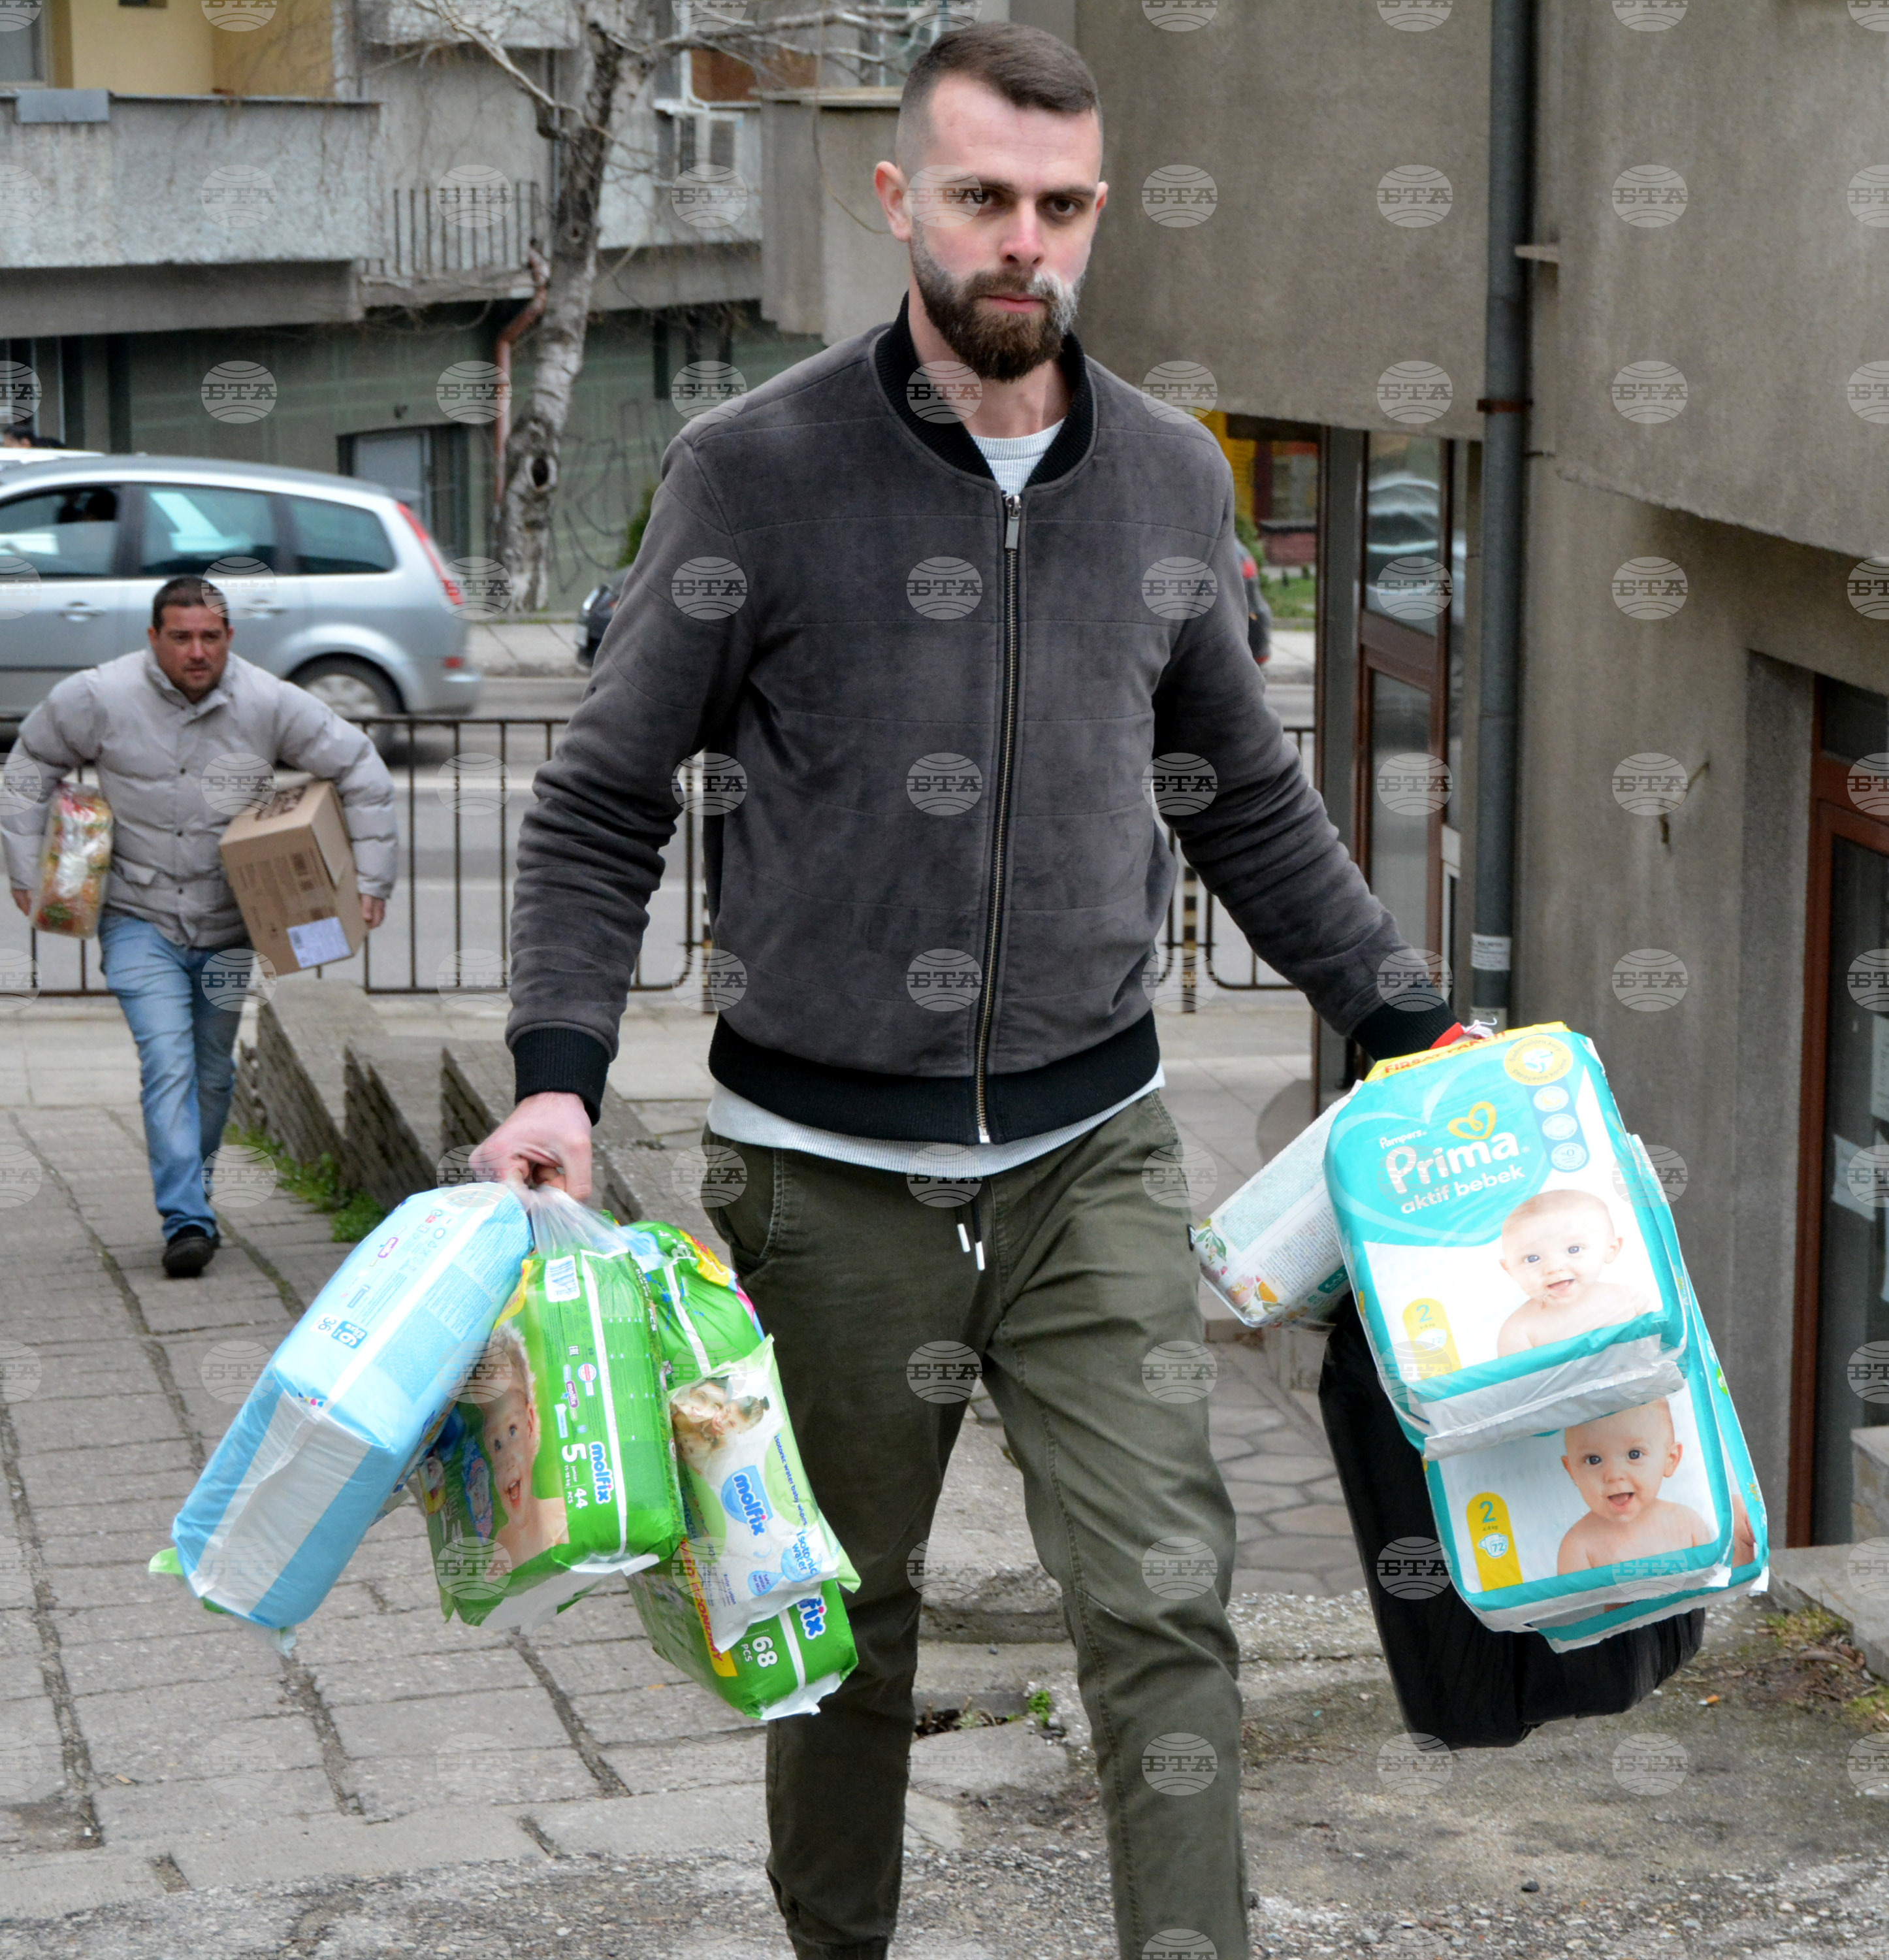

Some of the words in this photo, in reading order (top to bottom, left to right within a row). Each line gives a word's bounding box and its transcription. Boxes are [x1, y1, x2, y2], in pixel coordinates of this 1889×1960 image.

[1379, 1129, 1423, 1149] Pampers
[1385, 1131, 1519, 1195] Prima
[1400, 1186, 1451, 1214] aktif
[1453, 1164, 1526, 1196] bebek
[317, 1316, 337, 1333] 36
[1415, 1303, 1433, 1323] 2
[338, 1333, 359, 1346] 6
[566, 1382, 577, 1407] molfix
[561, 1443, 588, 1463] 5
[589, 1442, 613, 1504] molfix
[573, 1487, 589, 1509] 44
[732, 1473, 766, 1537] molfix
[784, 1463, 794, 1484] water
[790, 1484, 799, 1503] baby
[797, 1503, 808, 1526] wipes
[1479, 1500, 1496, 1523] 2
[792, 1543, 807, 1571] water
[1491, 1543, 1505, 1552] 72
[740, 1643, 754, 1663] PCS
[751, 1635, 779, 1669] 68
